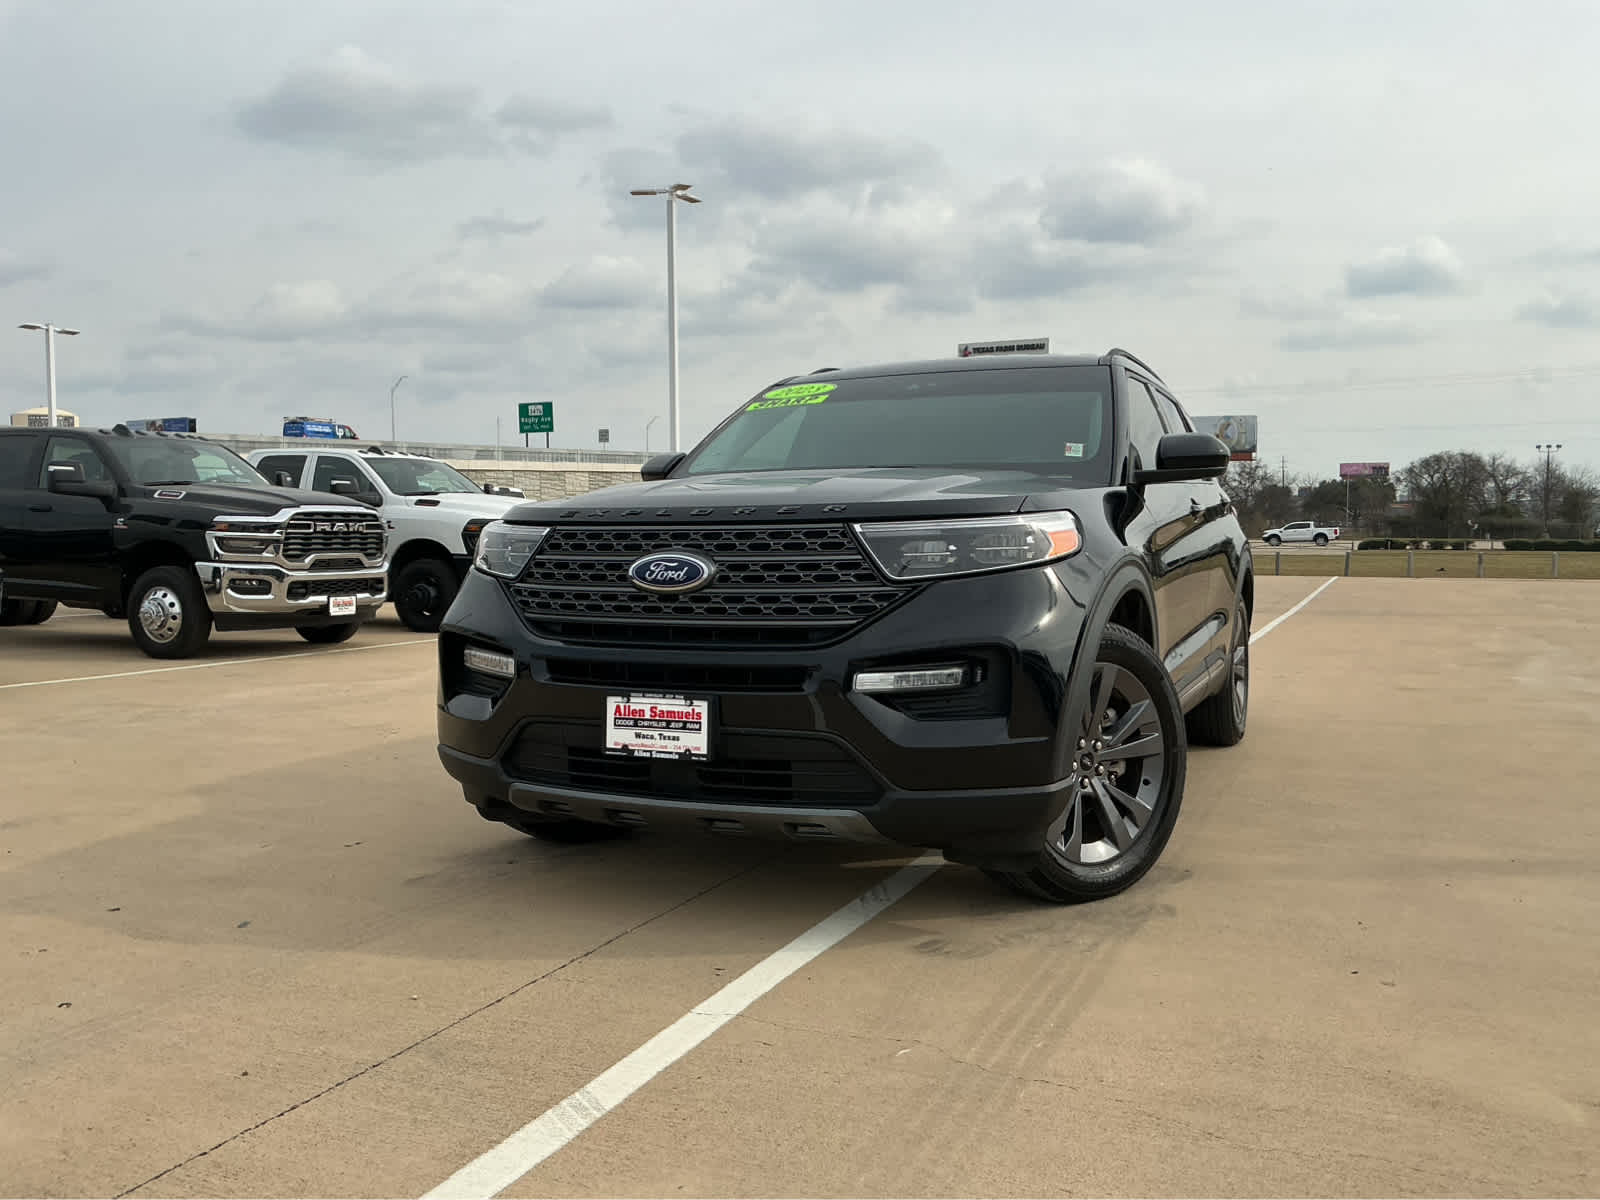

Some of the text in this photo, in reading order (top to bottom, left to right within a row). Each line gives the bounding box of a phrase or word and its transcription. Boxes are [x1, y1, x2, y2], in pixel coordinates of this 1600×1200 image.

[972, 343, 1046, 354] TEXAS FARM BUREAU
[560, 505, 847, 518] EXPLORER
[316, 522, 366, 532] RAM
[646, 561, 687, 581] Ford
[614, 704, 702, 720] Allen Samuels
[637, 719, 666, 728] CHRYSLER
[634, 732, 680, 741] Waco, Texas
[652, 751, 679, 759] Samuels
